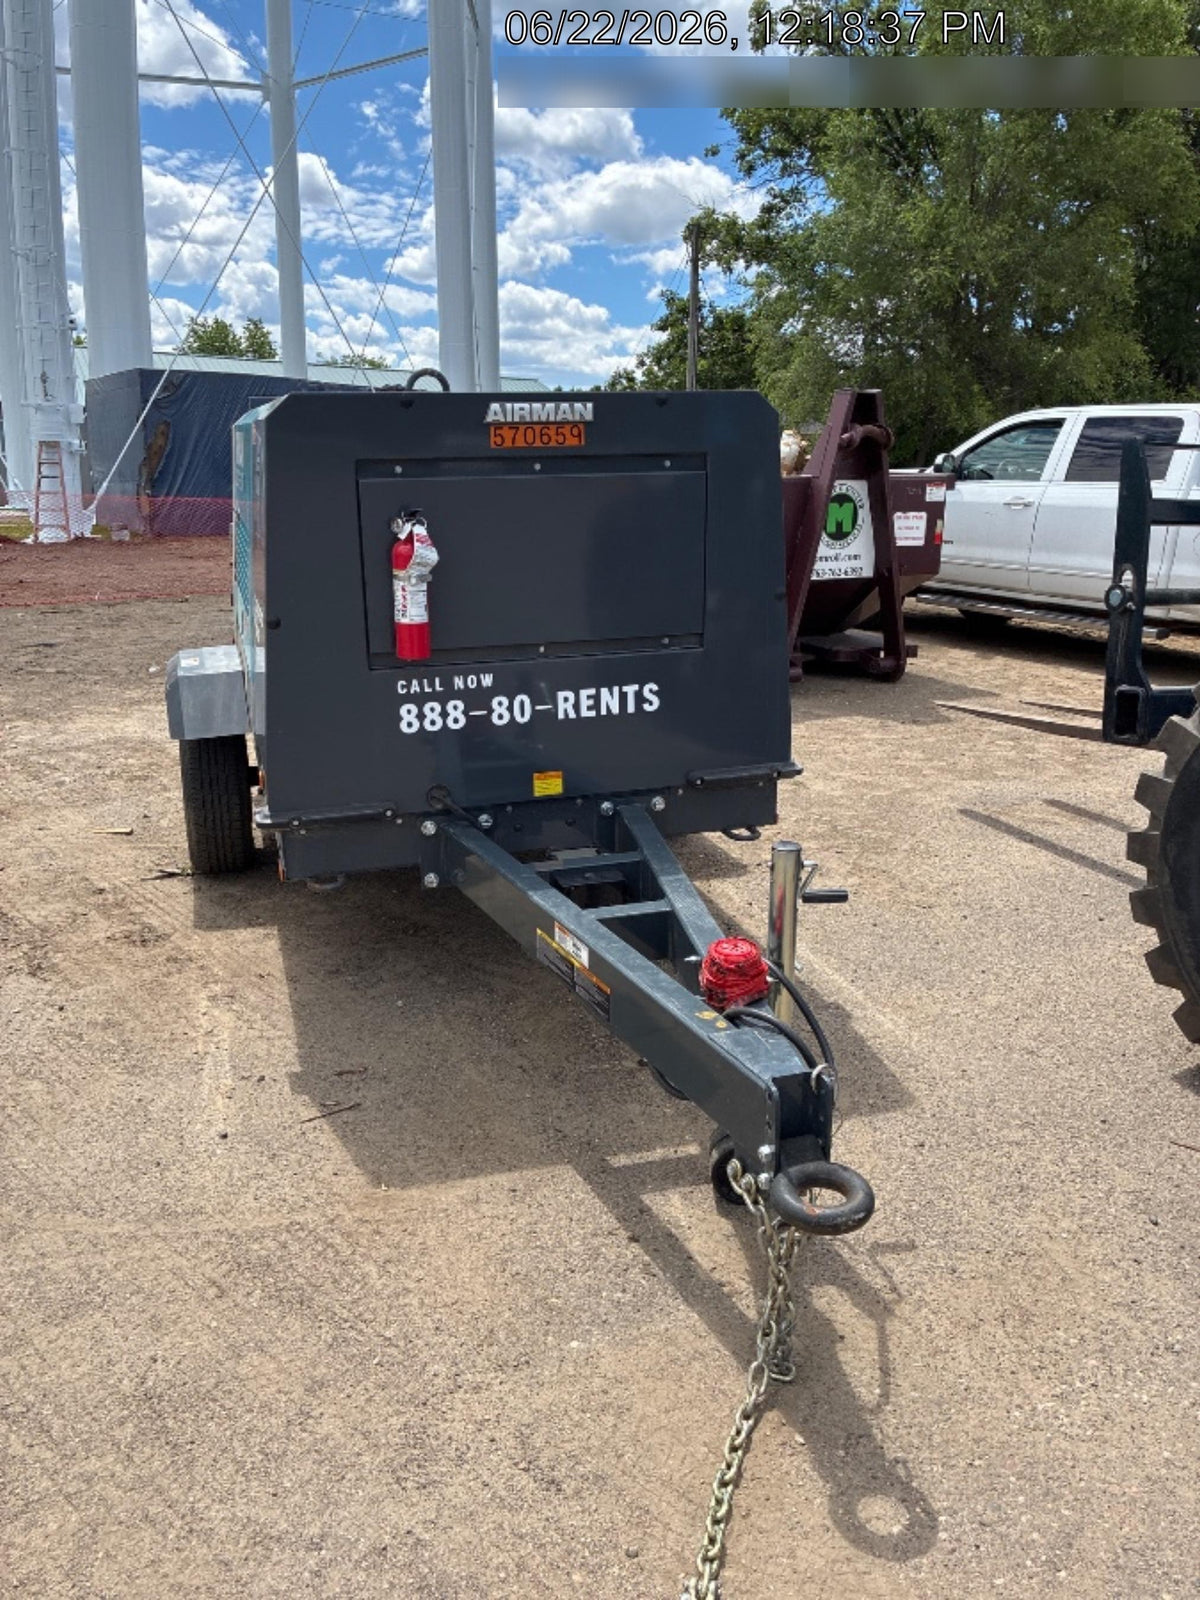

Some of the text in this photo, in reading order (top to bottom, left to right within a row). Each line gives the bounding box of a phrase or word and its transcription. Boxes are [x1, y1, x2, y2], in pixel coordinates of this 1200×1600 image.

[484, 402, 594, 422] AIRMAN
[493, 425, 582, 447] 570659
[826, 502, 854, 533] M
[397, 673, 494, 694] CALL NOW
[399, 682, 661, 734] 888-80-RENTS
